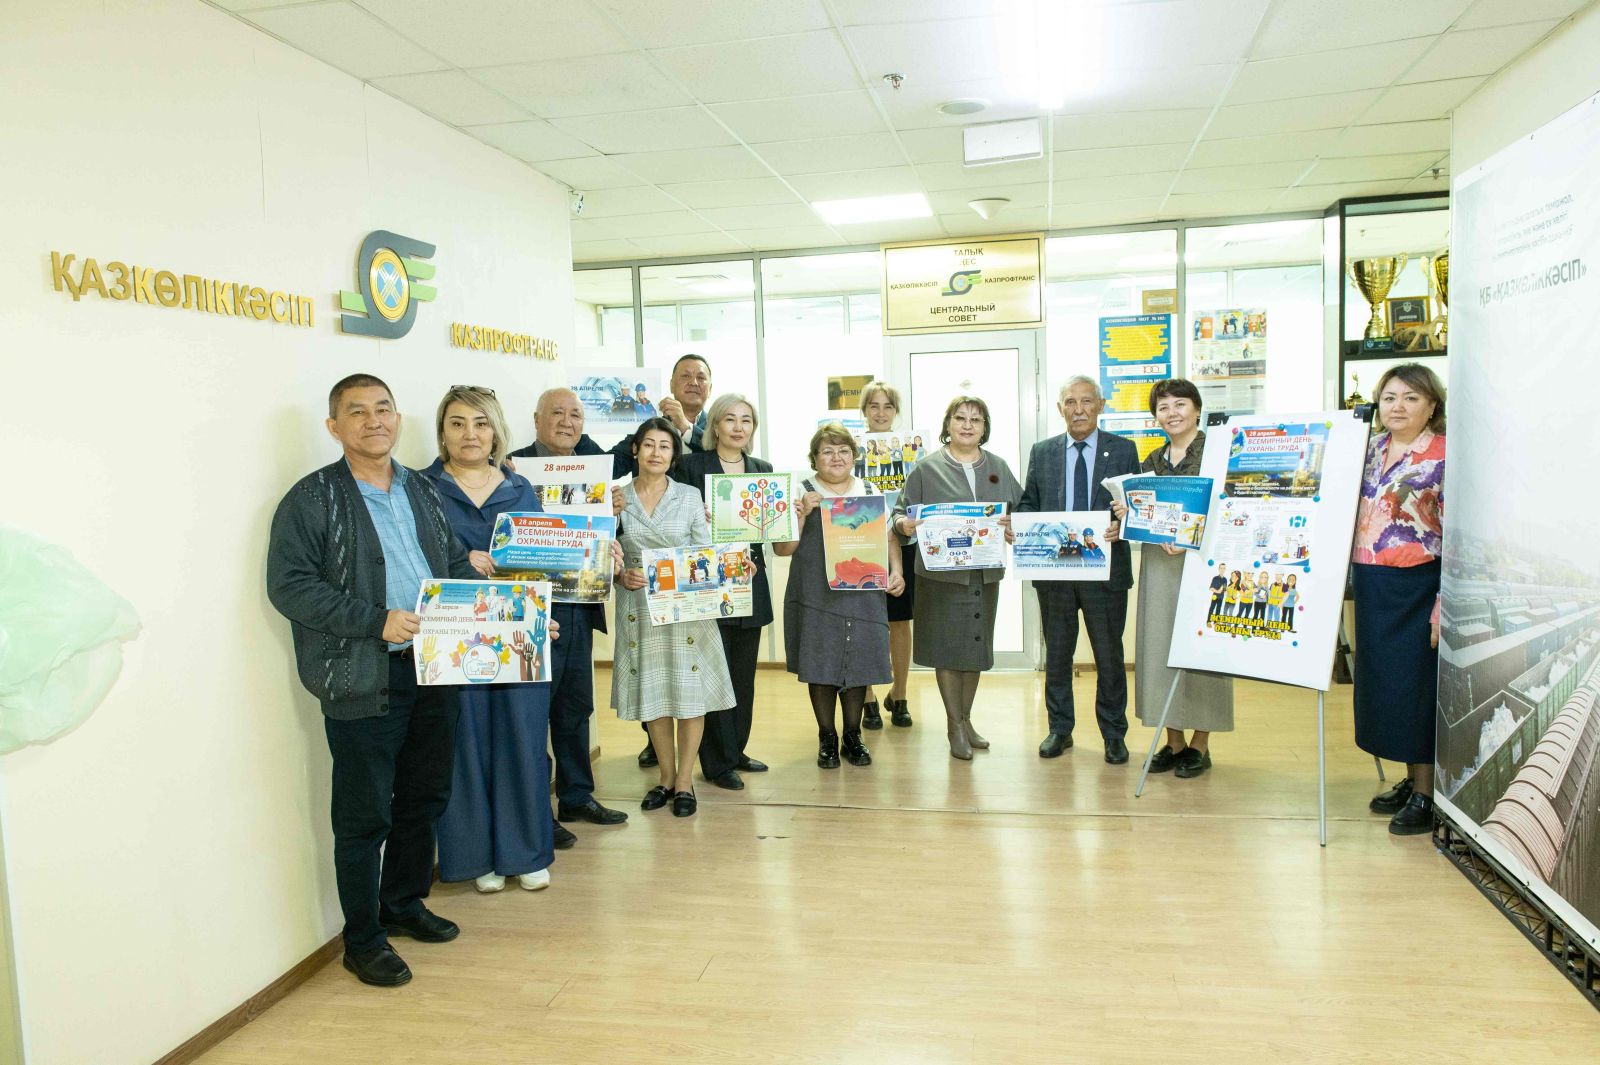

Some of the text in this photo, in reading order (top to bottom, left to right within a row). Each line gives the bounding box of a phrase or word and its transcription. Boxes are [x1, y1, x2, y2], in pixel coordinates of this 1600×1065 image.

[953, 246, 984, 257] ТАЛЫҚ
[51, 250, 315, 328] ҚАЗКӨЛІККӘСІП
[930, 302, 996, 315] ЦЕНТРАЛЬНЫЙ
[948, 314, 978, 323] СОВЕТ
[449, 321, 559, 361] КАЗПРОФТРАНС
[830, 388, 862, 397] ПРИЕМН
[1277, 444, 1299, 452] ТРУДА
[544, 463, 585, 473] 28 апреля
[528, 520, 553, 528] апреля
[517, 527, 598, 540] ВСЕМИРНЫЙ ДЕНЬ
[516, 537, 584, 548] ОХРАНЫ ТРУДА
[1210, 614, 1291, 631] ВСЕМИРНЫЙ ДЕНЬ
[1214, 624, 1282, 640] ОХРАНЫ ТРУДА
